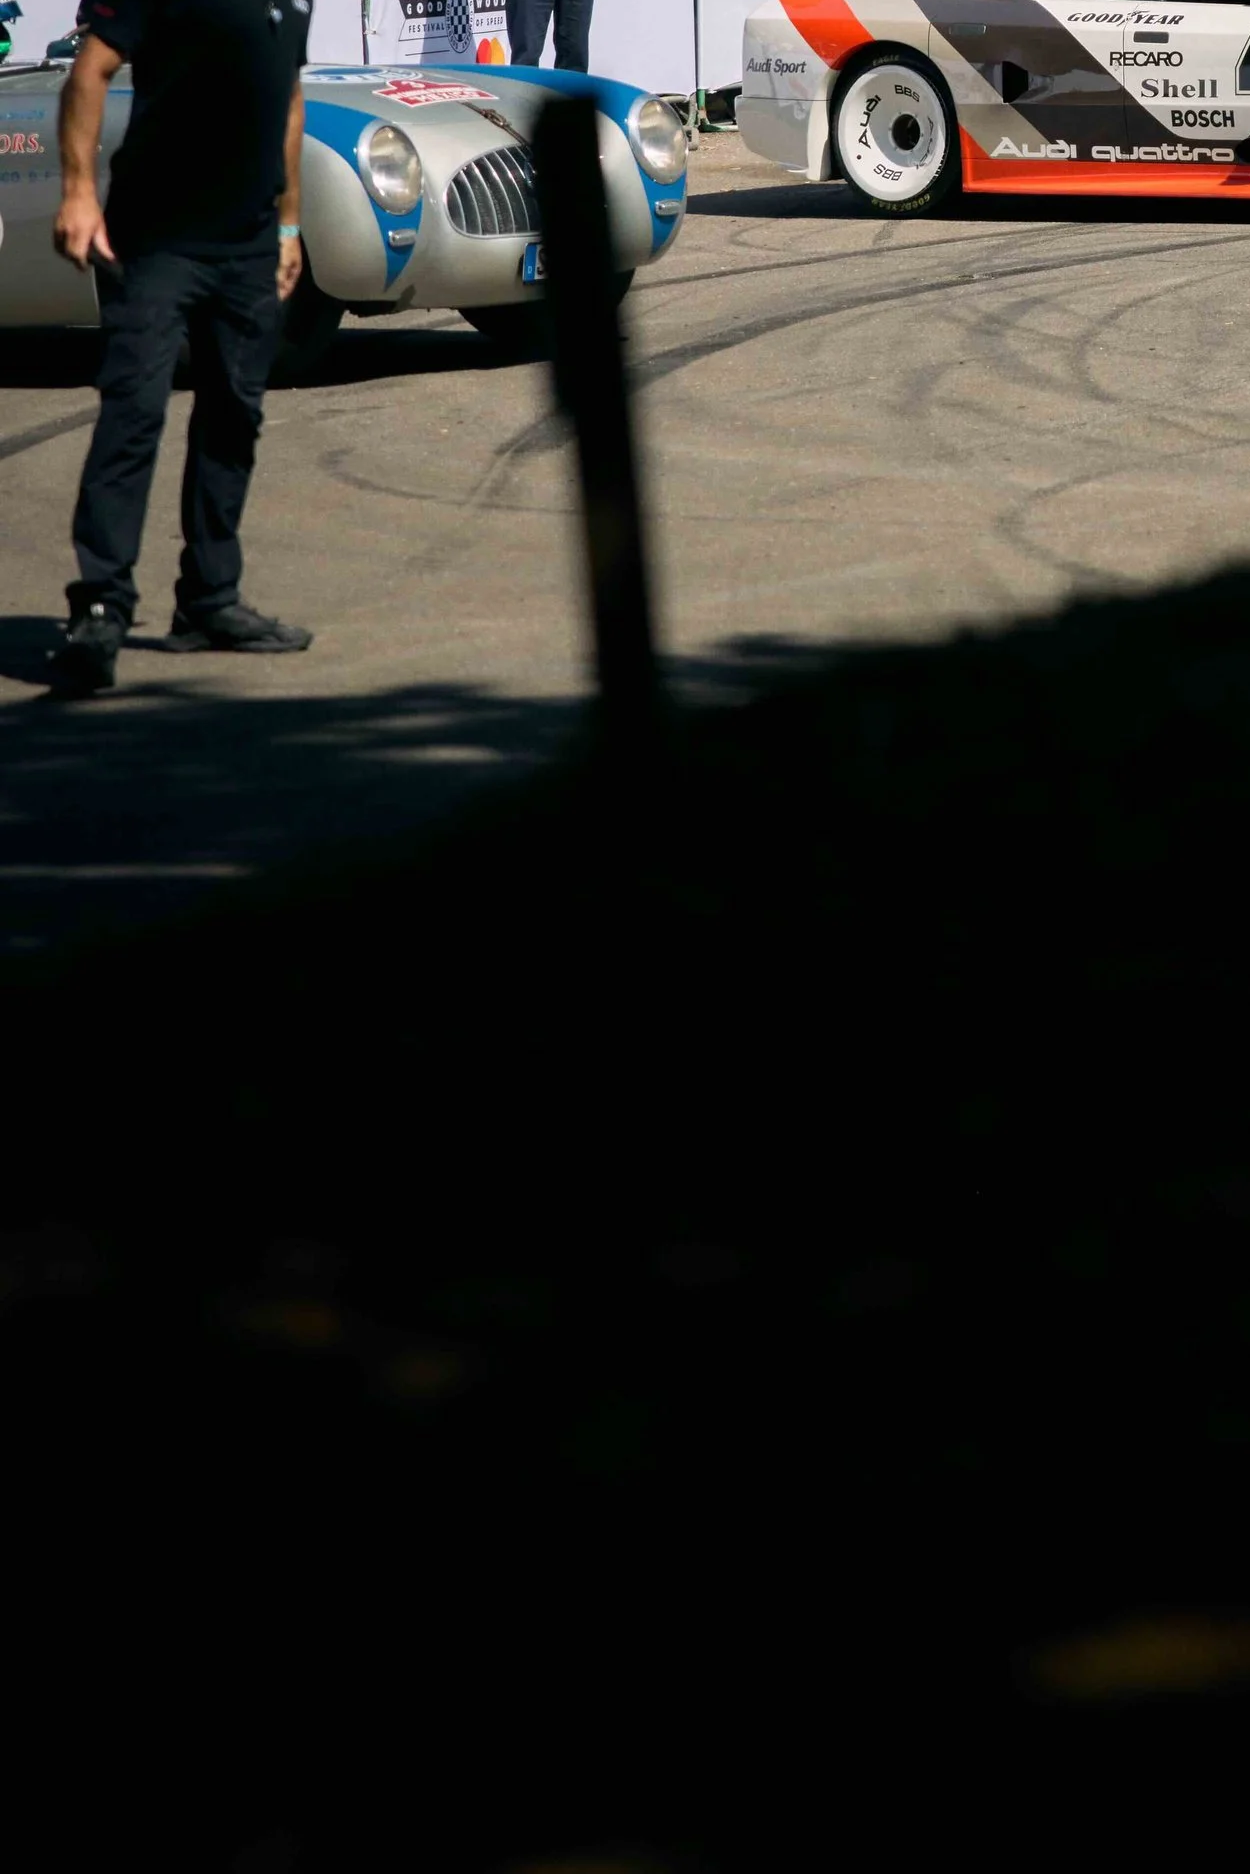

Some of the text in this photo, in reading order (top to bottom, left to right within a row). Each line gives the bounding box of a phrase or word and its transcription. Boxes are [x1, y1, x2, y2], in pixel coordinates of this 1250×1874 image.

[406, 1, 443, 15] GOOD
[408, 16, 503, 33] FESTIVAL OF SPEED
[746, 58, 807, 76] Audi Sport
[1109, 51, 1183, 67] RECARO
[894, 84, 920, 103] BBS
[1140, 78, 1219, 99] Shell
[1171, 109, 1236, 128] BOSCH
[0, 132, 45, 154] ORS.
[989, 136, 1236, 163] Audi quattro
[873, 163, 903, 182] BBS
